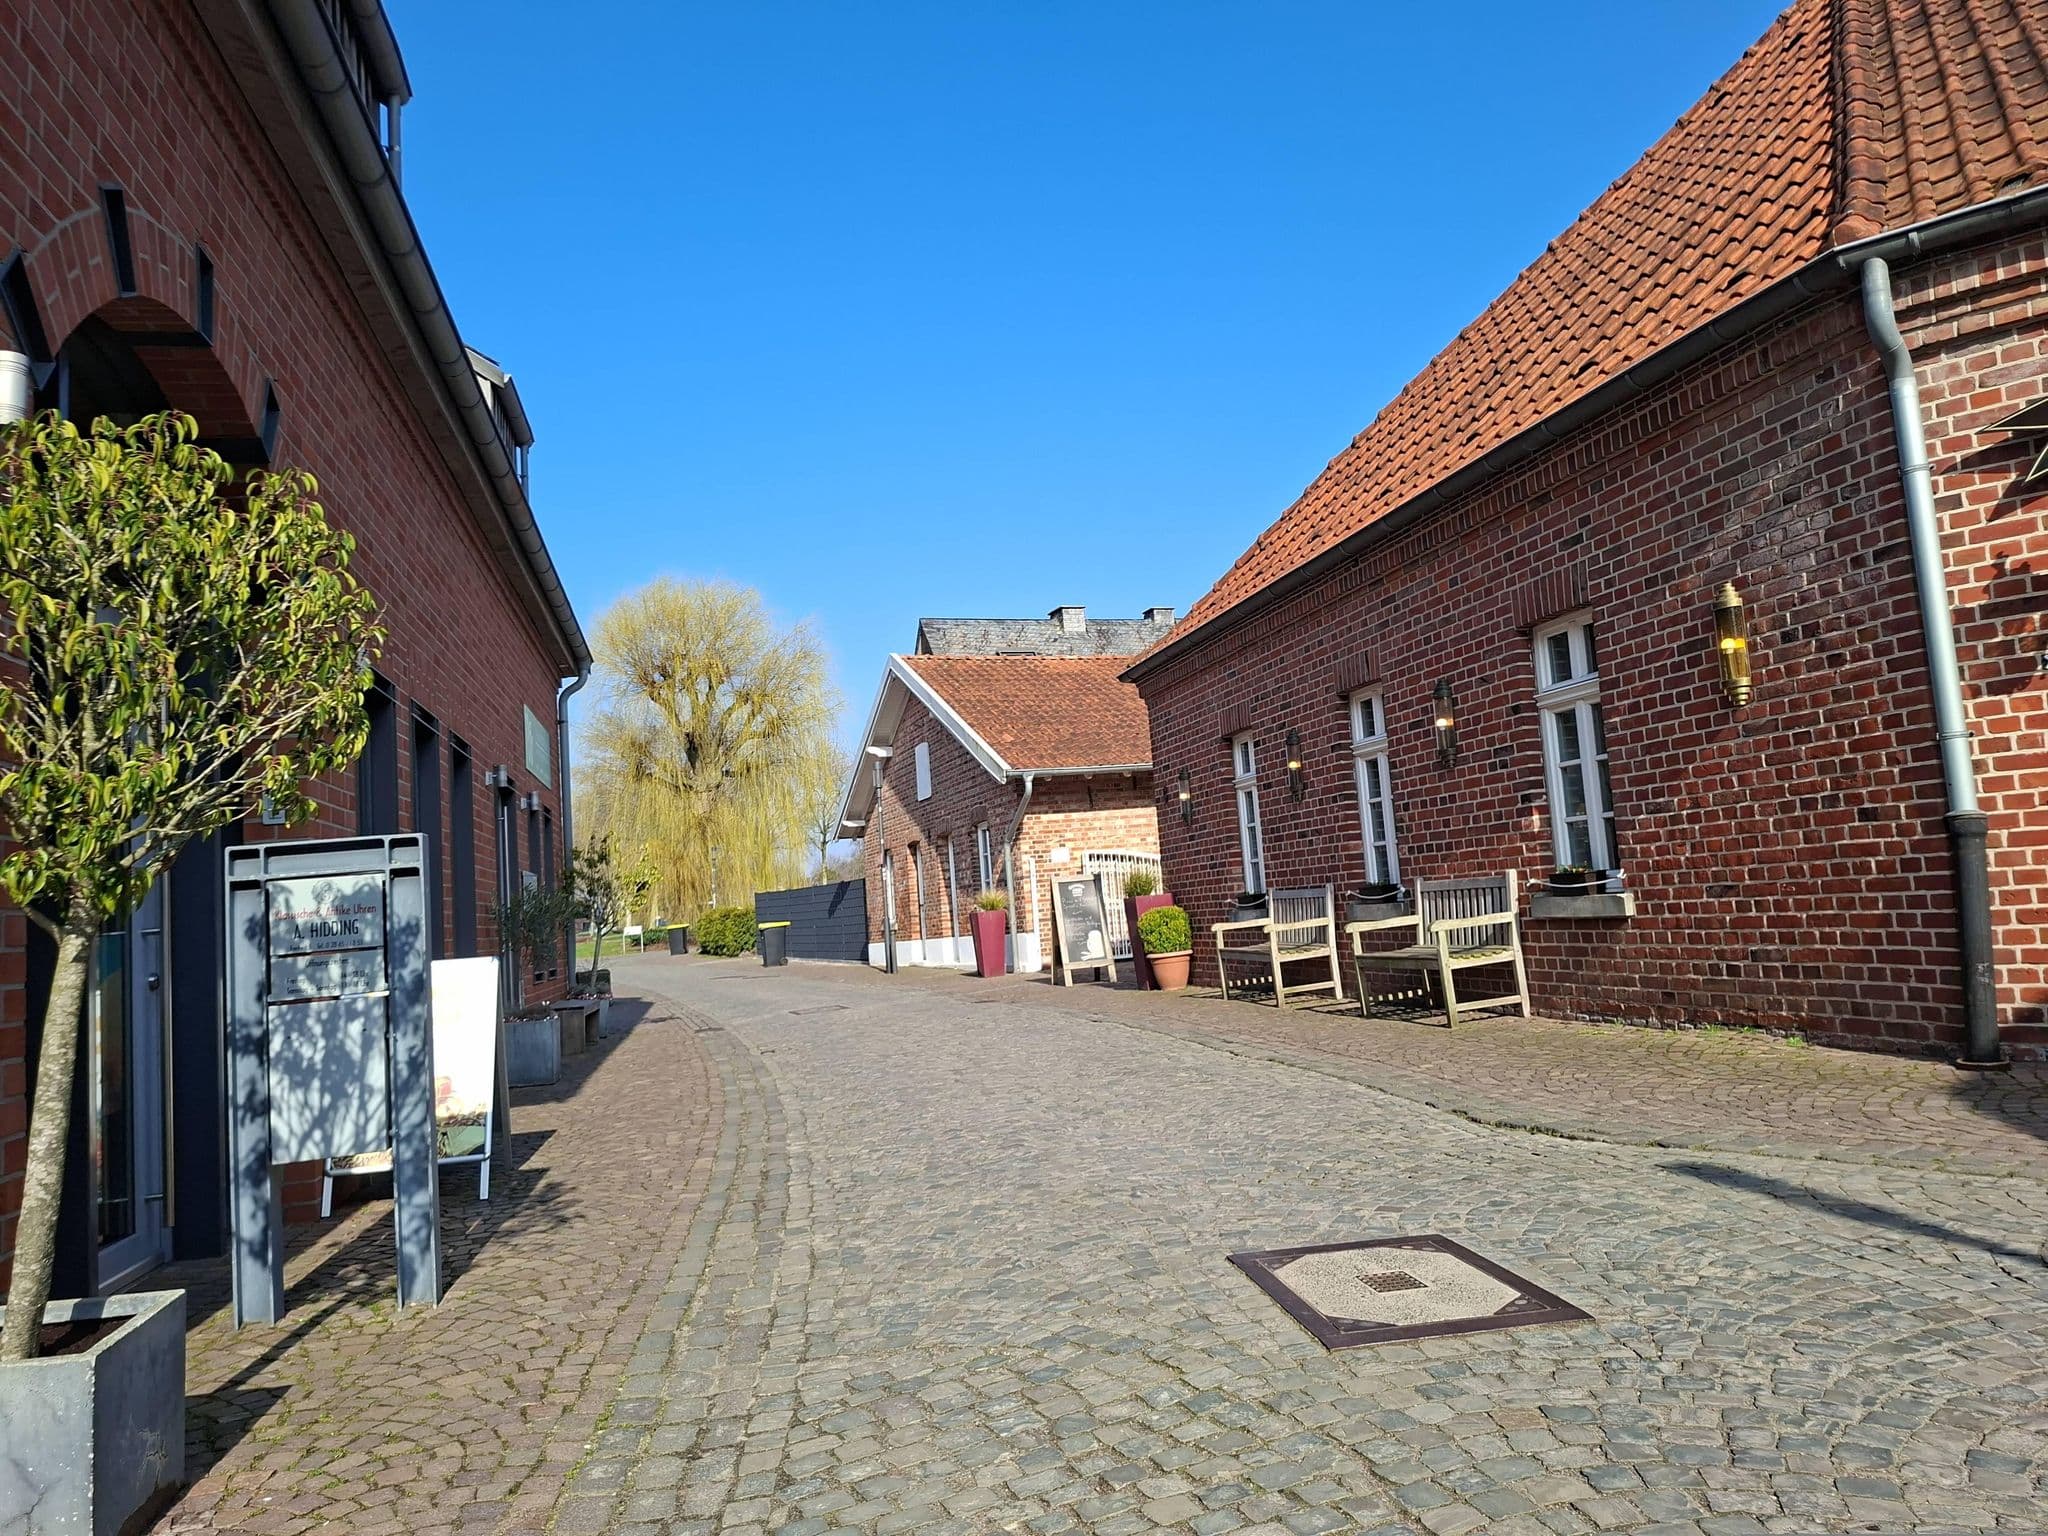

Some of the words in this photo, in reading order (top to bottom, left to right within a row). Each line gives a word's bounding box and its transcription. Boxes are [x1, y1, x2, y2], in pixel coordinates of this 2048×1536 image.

[353, 903, 377, 914] Uhren
[294, 924, 305, 940] A.
[310, 919, 359, 938] HIDDING
